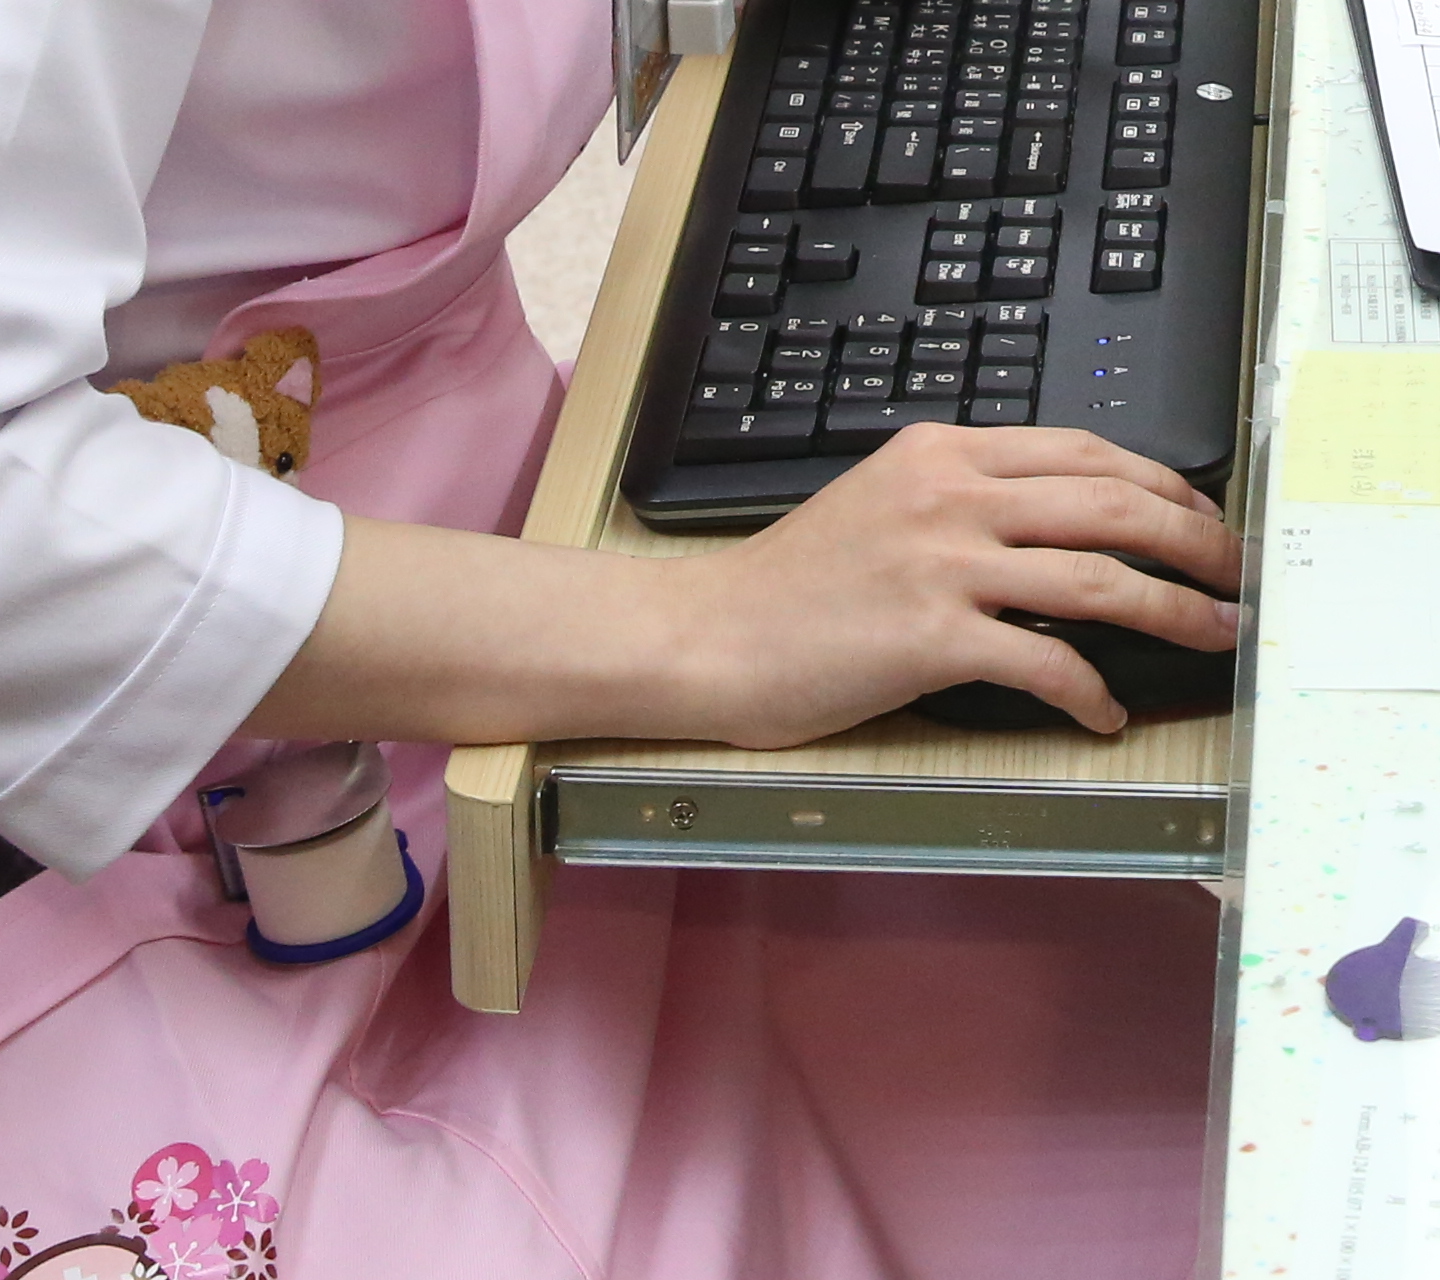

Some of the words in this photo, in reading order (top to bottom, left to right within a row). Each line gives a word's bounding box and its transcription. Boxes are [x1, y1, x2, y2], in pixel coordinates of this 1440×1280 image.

[987, 65, 1005, 73] P
[843, 130, 858, 146] Shift
[904, 140, 917, 157] Enter
[1027, 142, 1044, 171] Backspace
[953, 233, 967, 245] End
[1018, 229, 1031, 245] Home
[1006, 259, 1020, 269] Up
[1020, 259, 1035, 274] Page
[938, 263, 953, 280] Down
[951, 263, 966, 279] Page
[878, 313, 895, 323] 4
[922, 309, 937, 326] Home
[946, 310, 963, 319] 7
[999, 306, 1013, 320] Lock
[1014, 306, 1027, 320] Num
[740, 323, 758, 331] 0
[870, 347, 888, 355] 5
[941, 342, 960, 350] 8
[801, 350, 821, 358] 2
[864, 377, 882, 387] 6
[935, 374, 954, 382] 9
[795, 381, 813, 391] 3
[703, 386, 717, 399] Del
[740, 415, 755, 432] Enter
